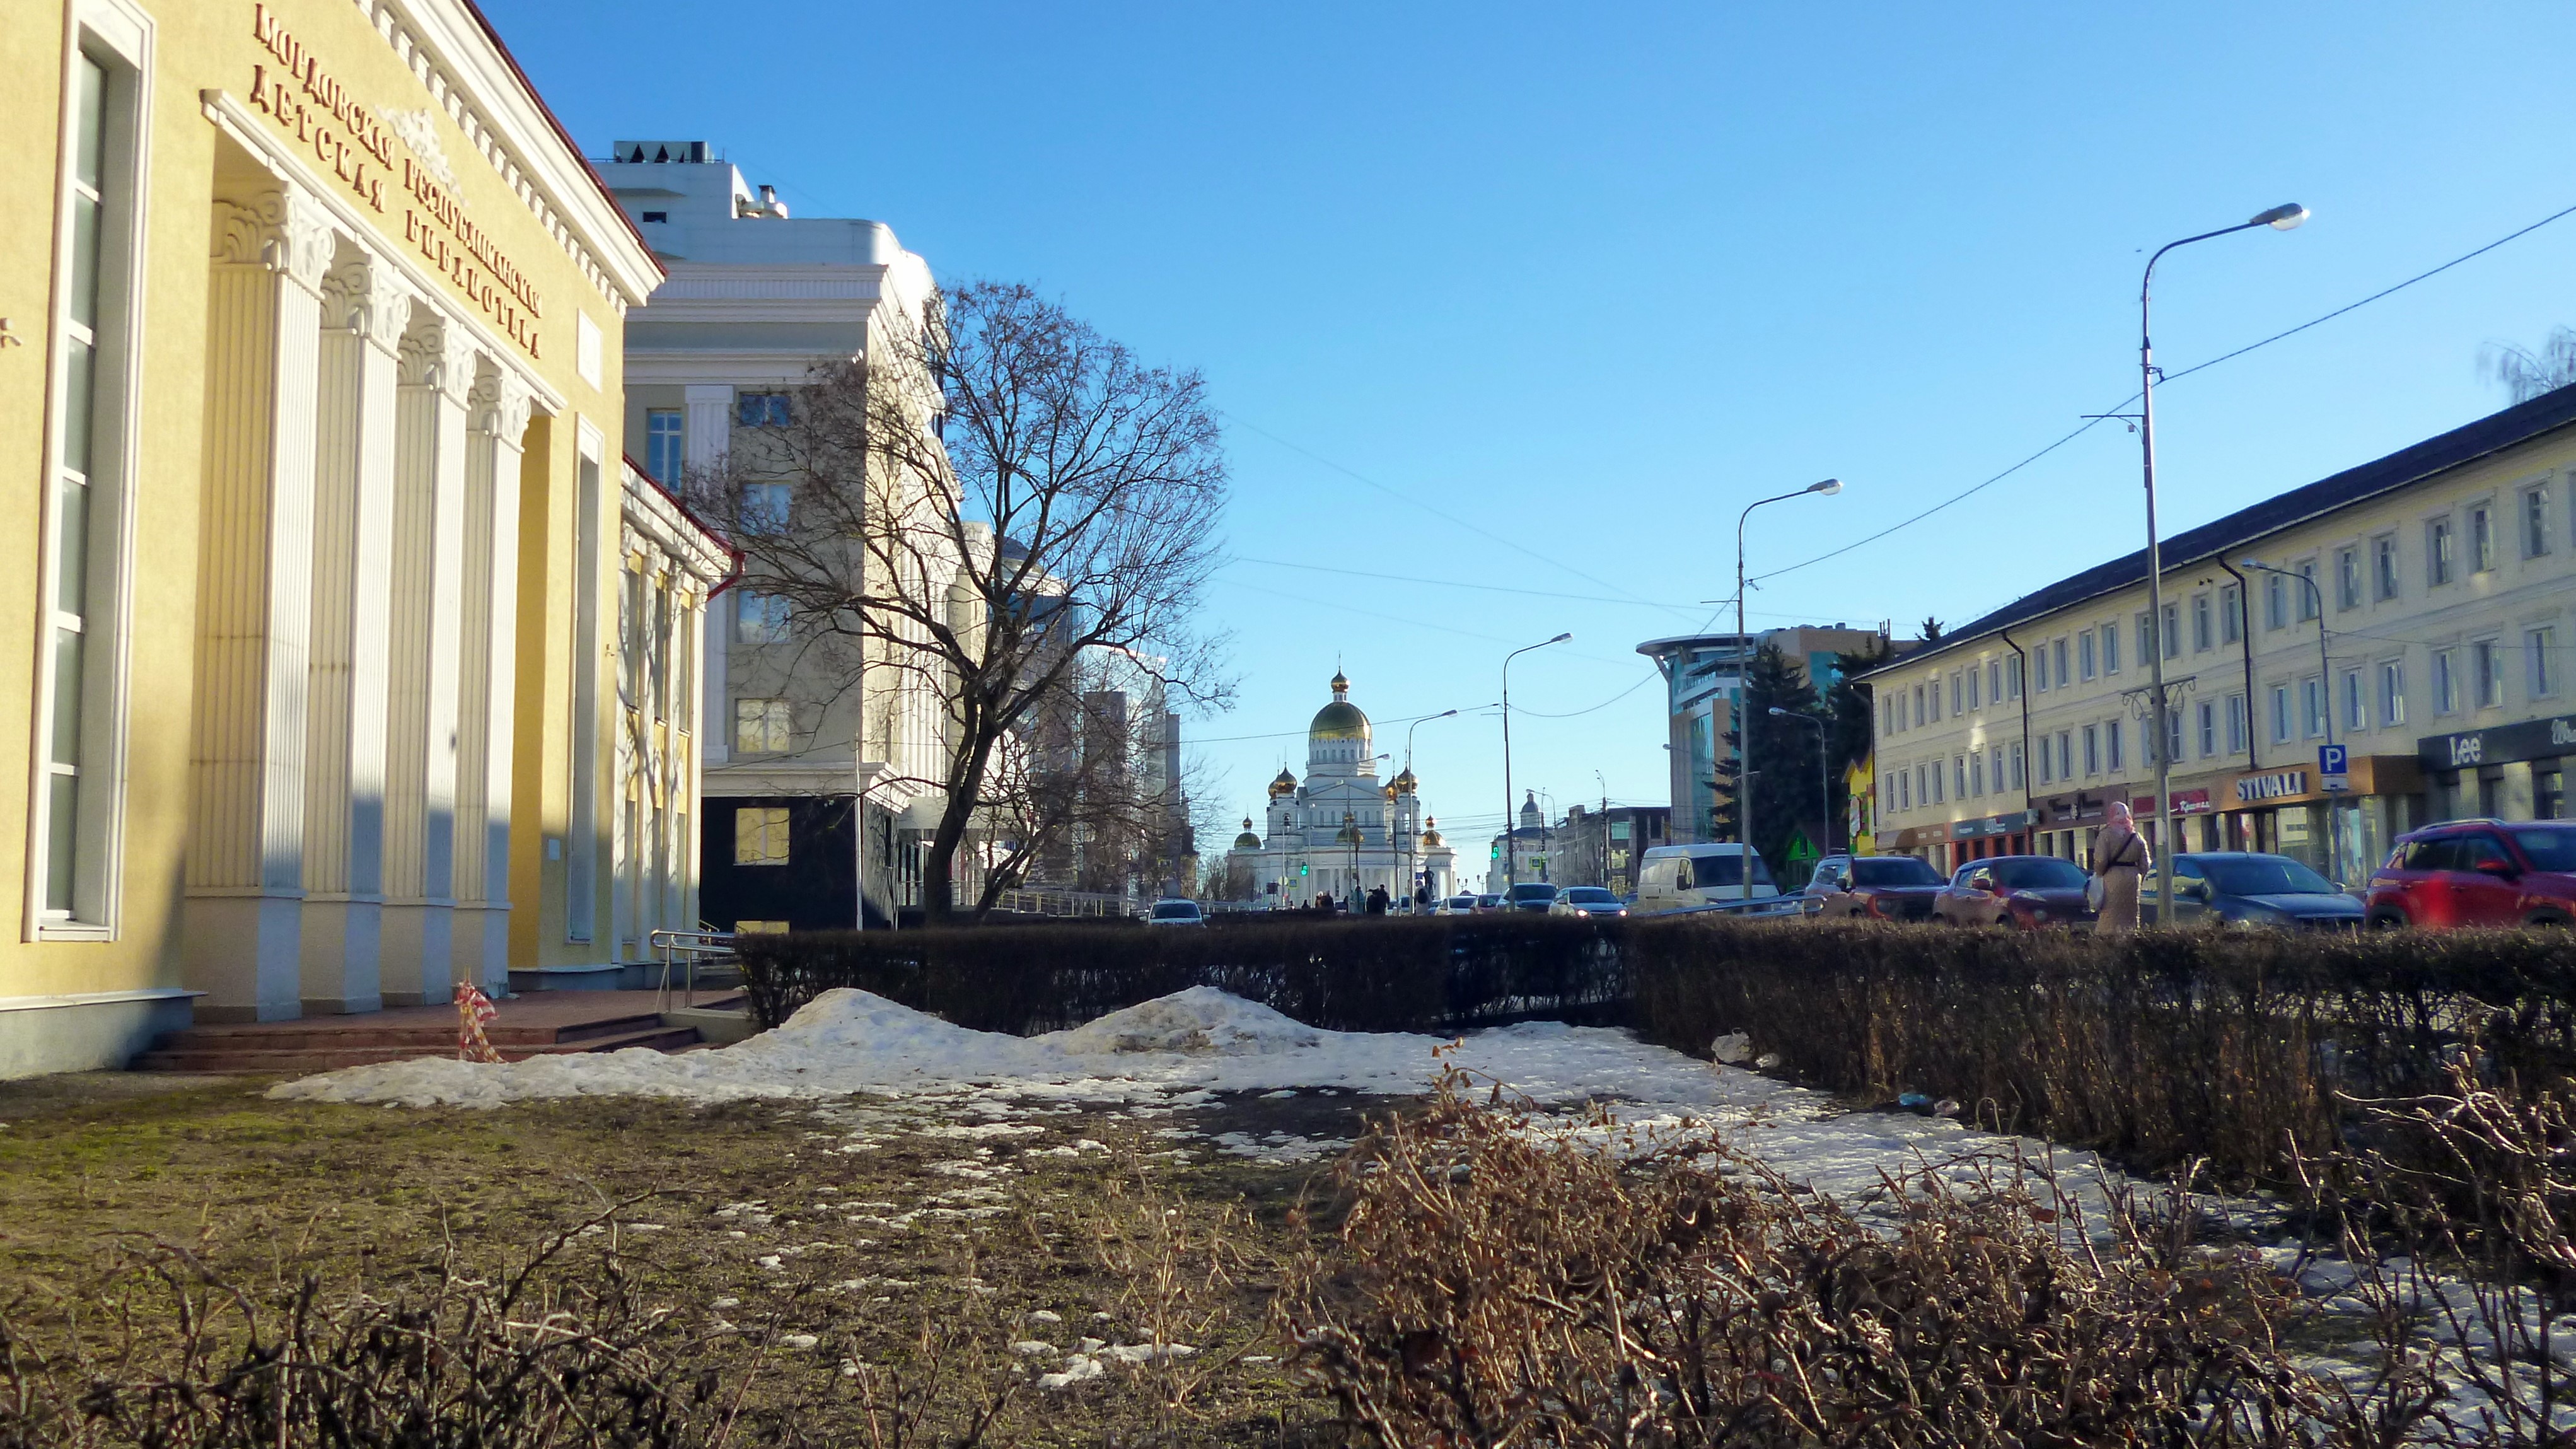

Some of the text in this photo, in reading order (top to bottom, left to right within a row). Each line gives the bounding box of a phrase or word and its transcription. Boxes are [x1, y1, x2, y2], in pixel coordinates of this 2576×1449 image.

[253, 3, 542, 319] МОРДОВСКАЯ РЕСПУБЛИКАНСКАЯ
[250, 64, 541, 359] ДЕТСКАЯ БИБЛИОТЕКА
[2326, 748, 2342, 771] P
[2449, 736, 2481, 765] Lee
[2236, 772, 2306, 801] STIVALI
